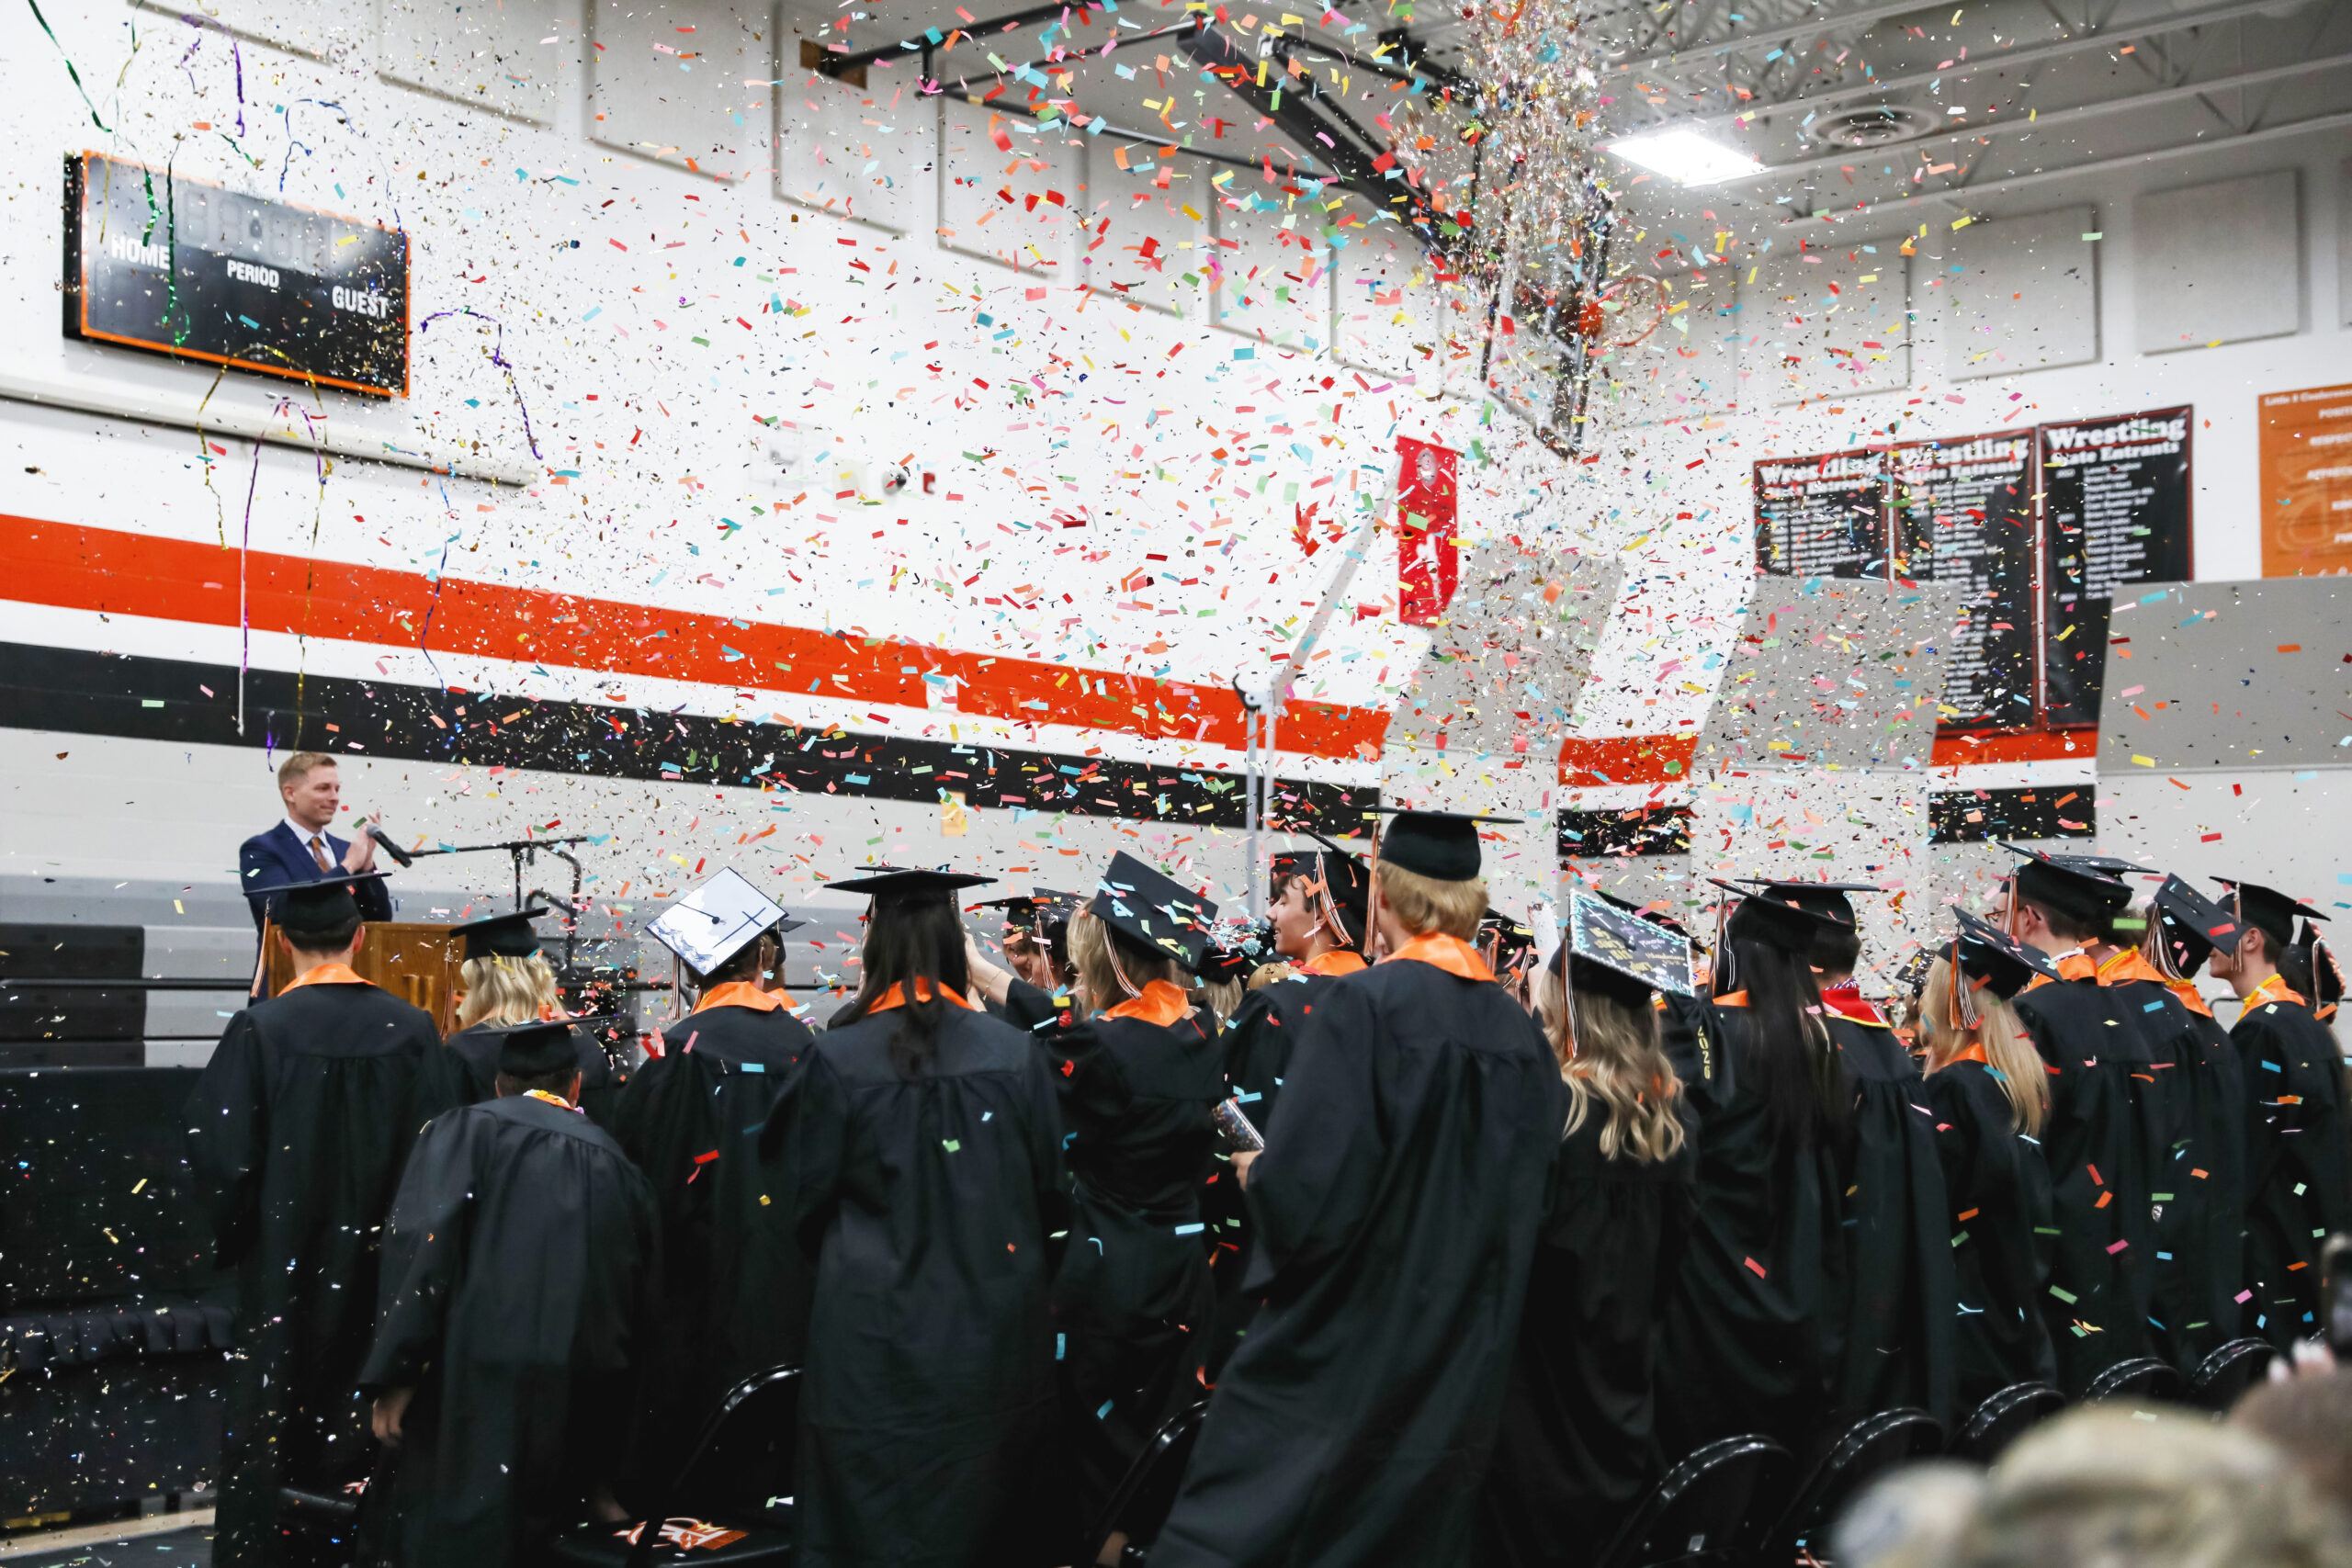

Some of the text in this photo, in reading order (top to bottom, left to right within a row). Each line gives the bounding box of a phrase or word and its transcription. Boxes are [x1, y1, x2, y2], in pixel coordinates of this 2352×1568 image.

[111, 234, 171, 270] HOME
[227, 260, 279, 288] PERIOD
[332, 285, 390, 319] GUEST
[2047, 417, 2187, 450] Wrestling
[1899, 437, 2029, 466] Wrestling
[2100, 441, 2180, 461] Entrants
[1759, 457, 1881, 485] Wrestling
[1950, 459, 2024, 478] Entrants
